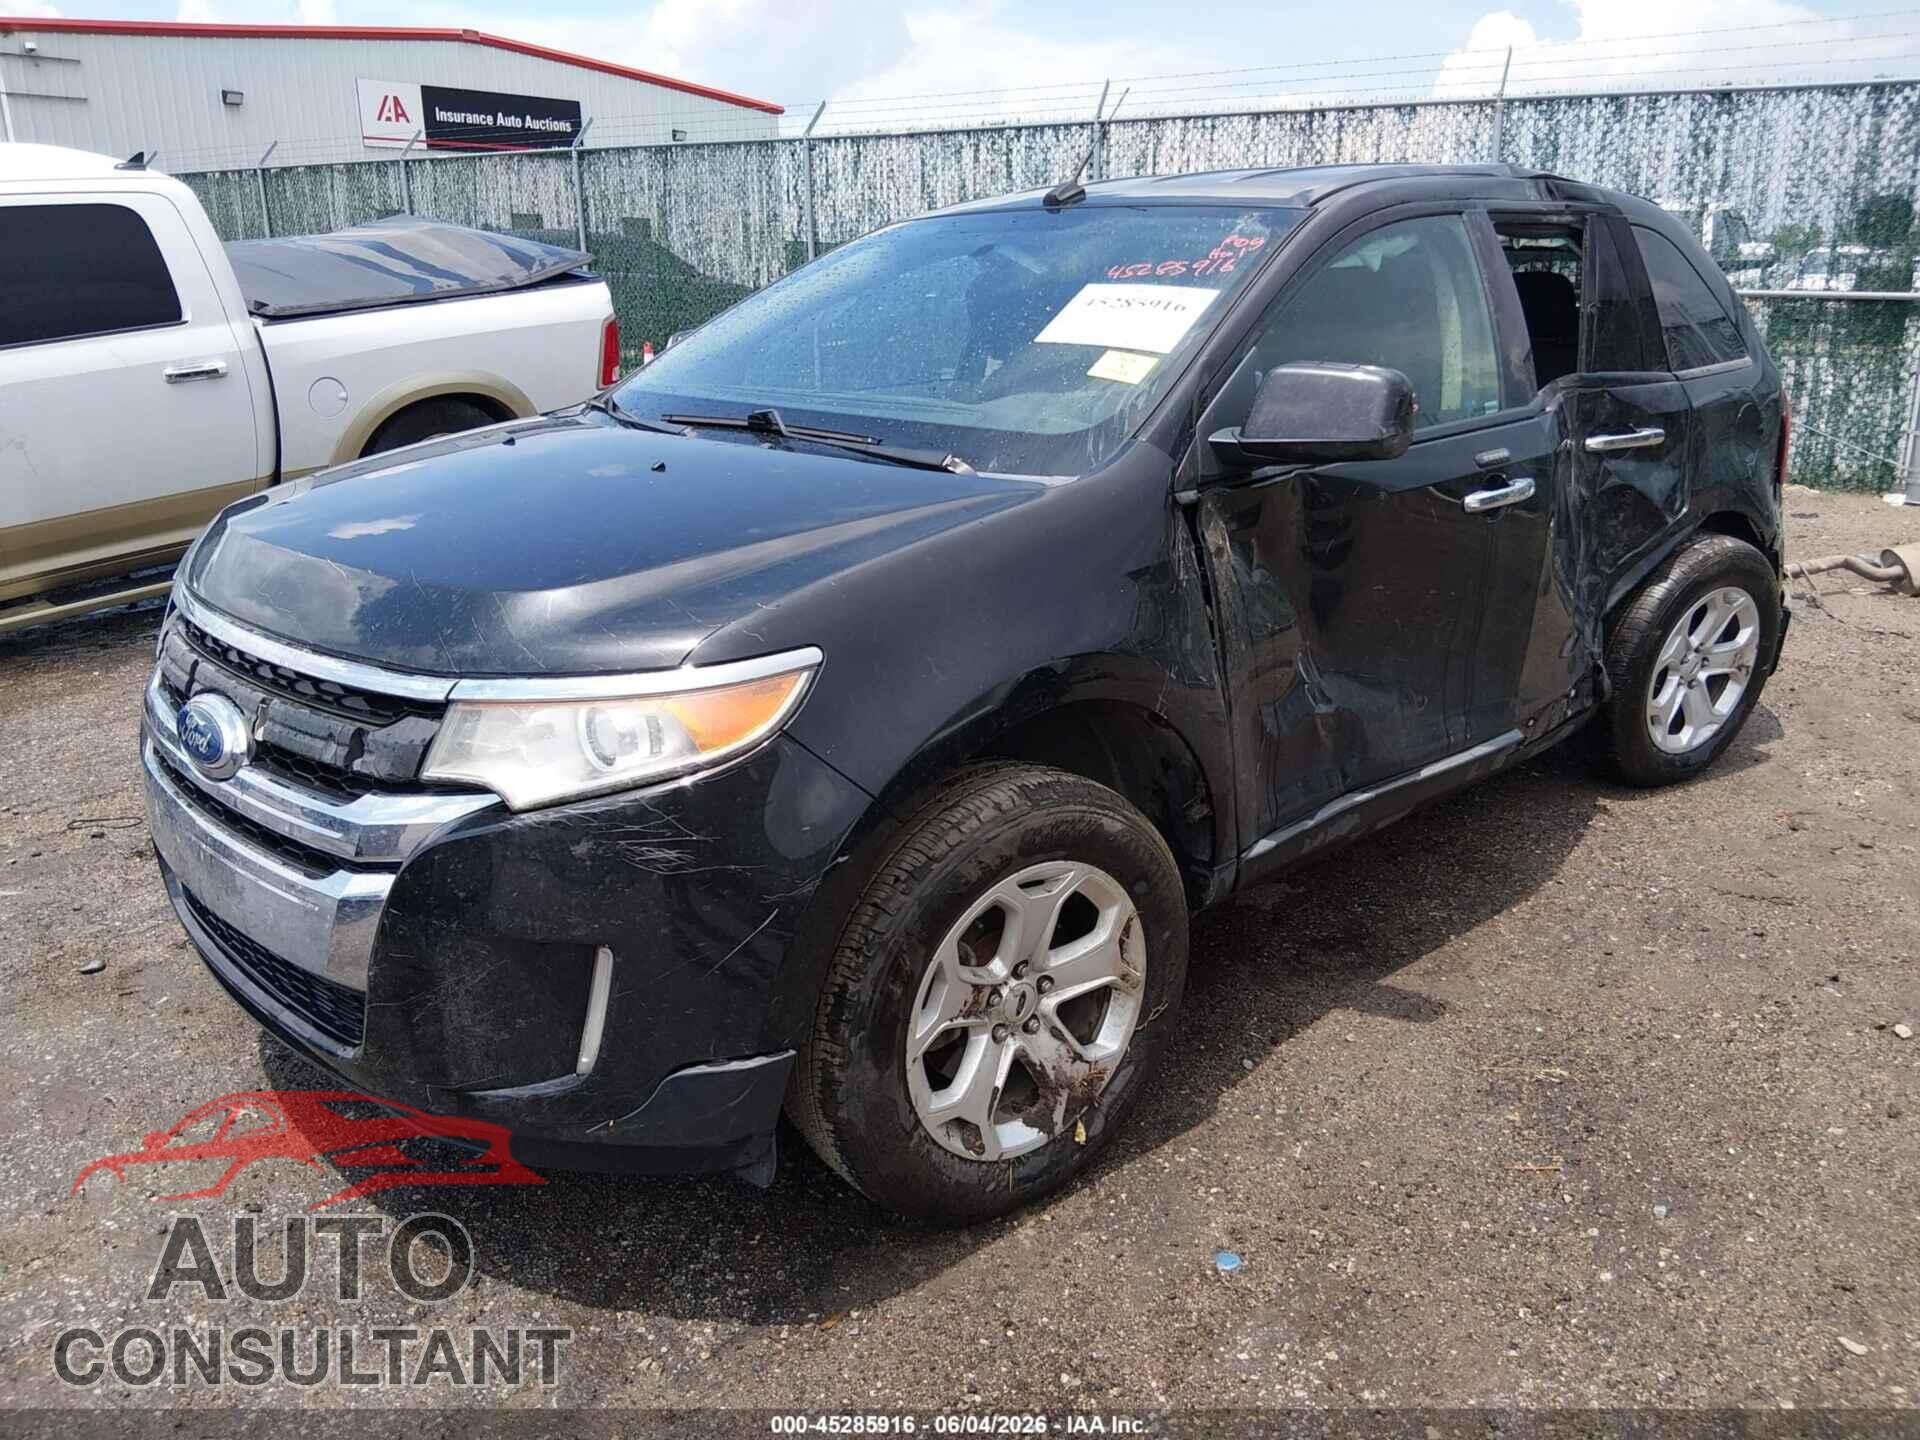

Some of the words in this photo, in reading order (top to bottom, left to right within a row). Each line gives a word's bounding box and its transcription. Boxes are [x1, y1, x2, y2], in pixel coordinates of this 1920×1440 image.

[435, 106, 493, 126] Insurance
[496, 112, 522, 129] Auto
[524, 114, 572, 133] Auctions
[182, 710, 212, 754] Ford
